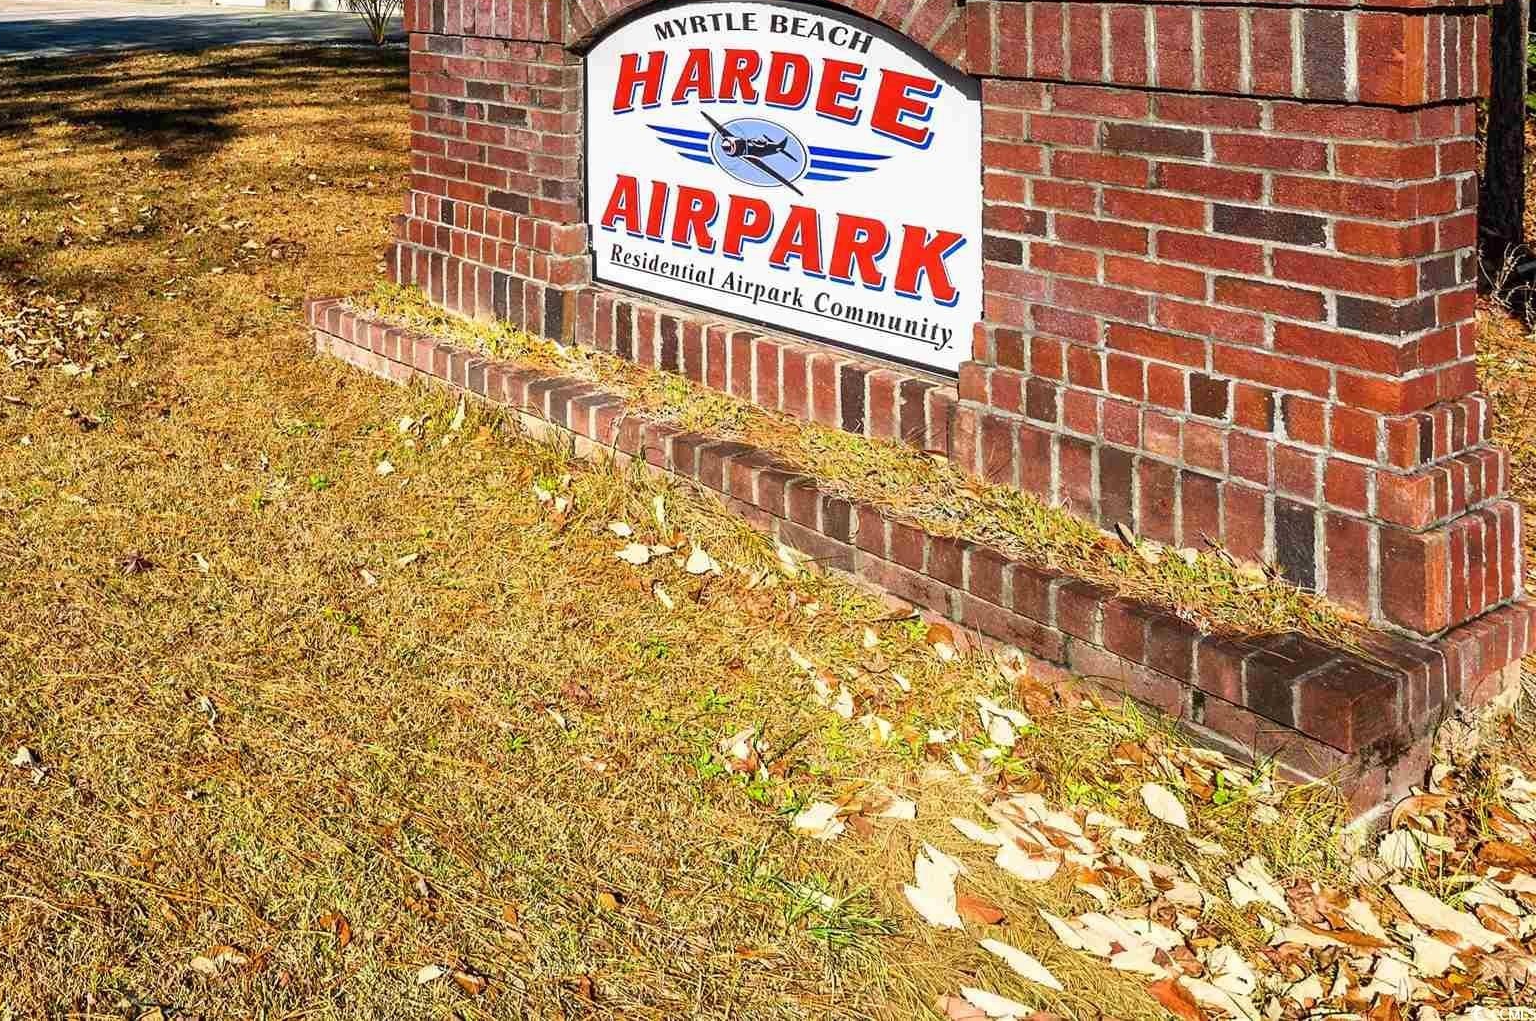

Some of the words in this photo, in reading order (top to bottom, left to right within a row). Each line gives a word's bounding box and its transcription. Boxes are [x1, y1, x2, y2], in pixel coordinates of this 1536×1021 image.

[654, 11, 757, 42] MYRTLE
[770, 14, 873, 55] BEACH
[612, 48, 942, 150] HARDEE
[600, 174, 967, 308] AIRPARK
[610, 243, 715, 287] Residential
[721, 270, 804, 306] Airpark
[813, 292, 954, 351] Community
